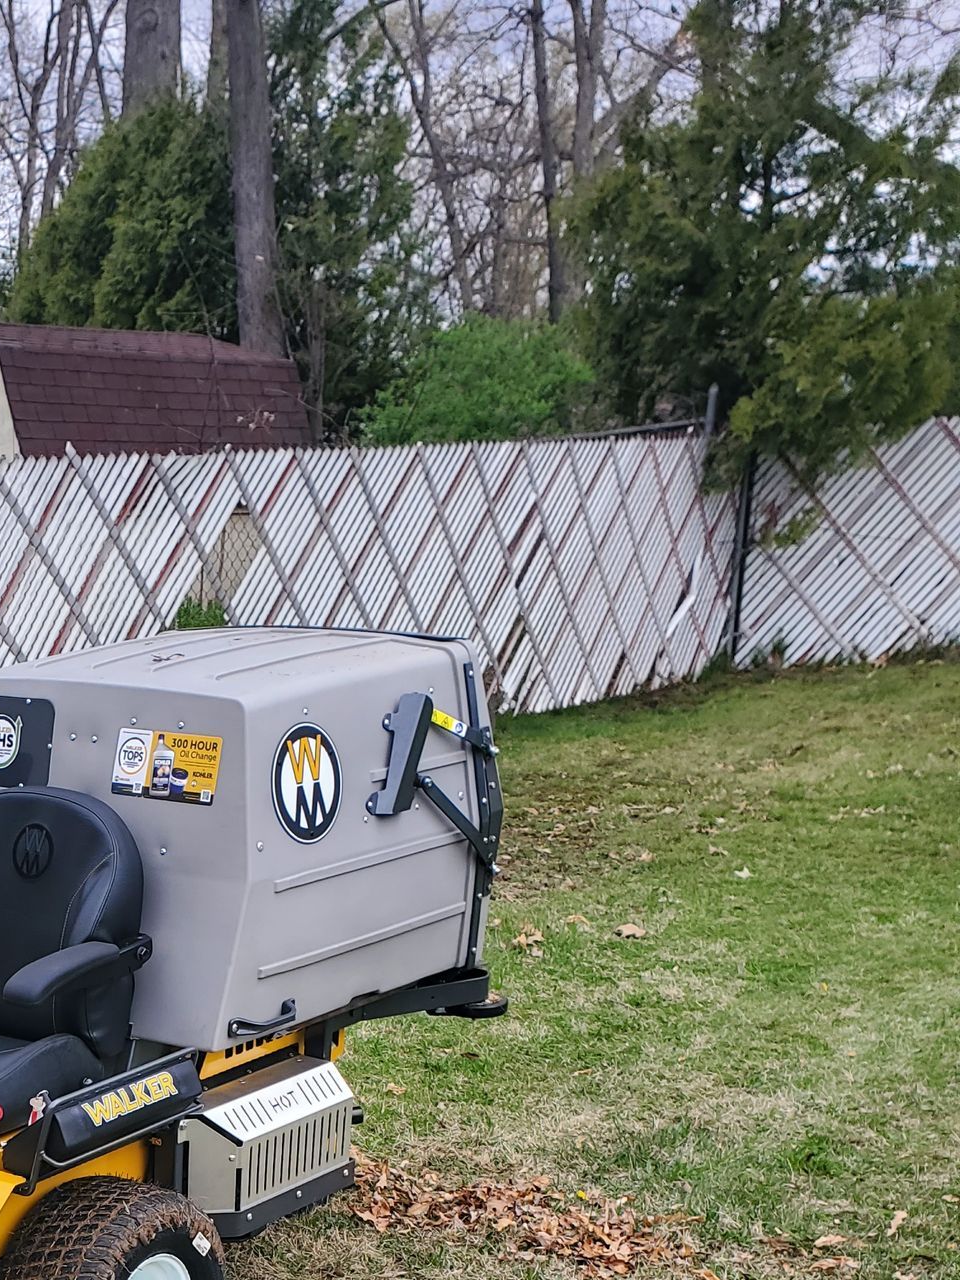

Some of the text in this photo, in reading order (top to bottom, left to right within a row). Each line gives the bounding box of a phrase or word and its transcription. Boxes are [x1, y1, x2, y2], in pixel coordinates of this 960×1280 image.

[171, 738, 218, 753] 300 HOUR
[122, 749, 144, 762] TOPS
[179, 750, 217, 762] Oil Change
[81, 1071, 179, 1127] WALKER
[268, 1090, 299, 1113] HOT
